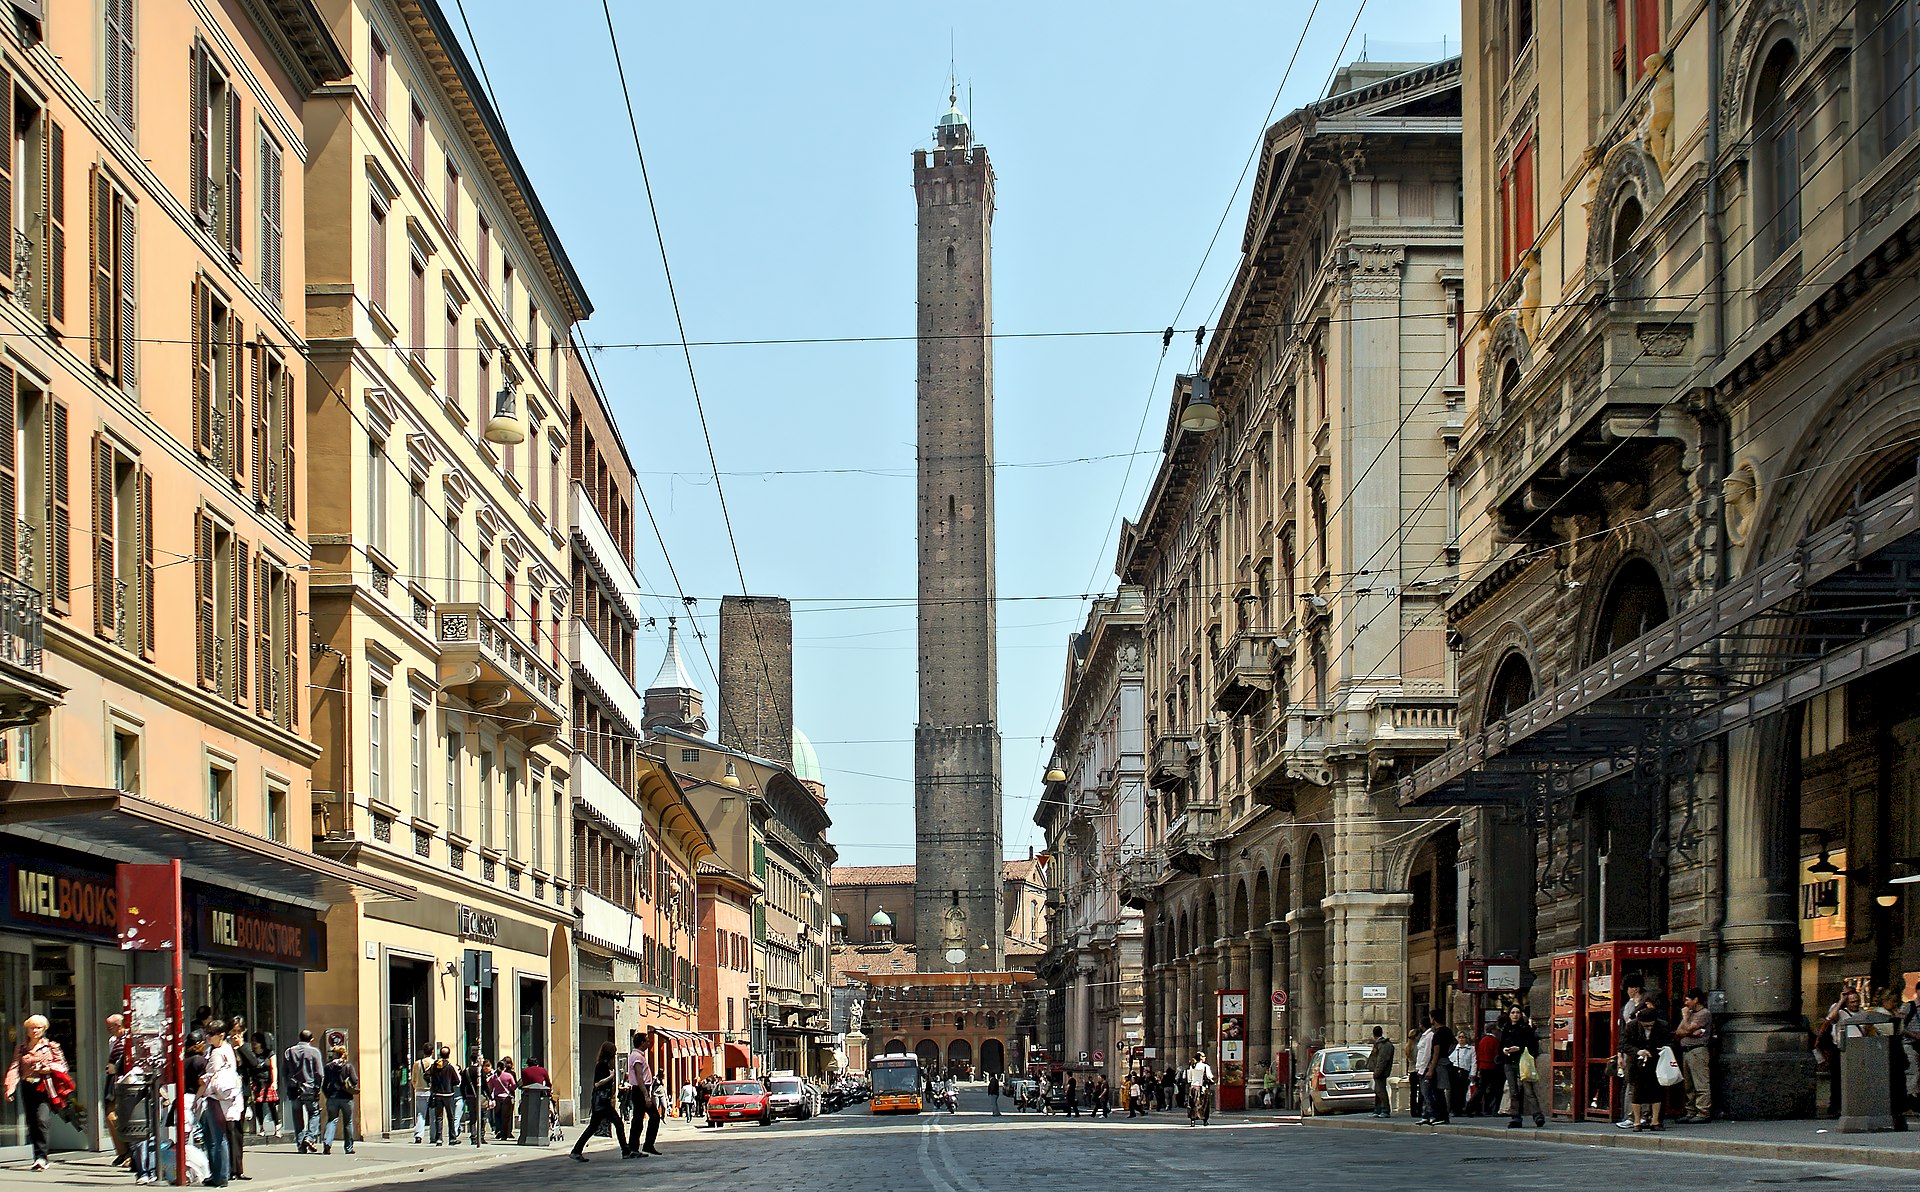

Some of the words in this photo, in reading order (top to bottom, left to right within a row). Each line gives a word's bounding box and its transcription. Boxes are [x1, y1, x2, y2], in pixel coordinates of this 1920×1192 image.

[1384, 587, 1397, 599] 14
[18, 869, 118, 928] MELBOOKS
[212, 910, 301, 958] MELBOOKSTORE
[1626, 946, 1684, 955] TELEFONO
[1080, 1052, 1088, 1061] P
